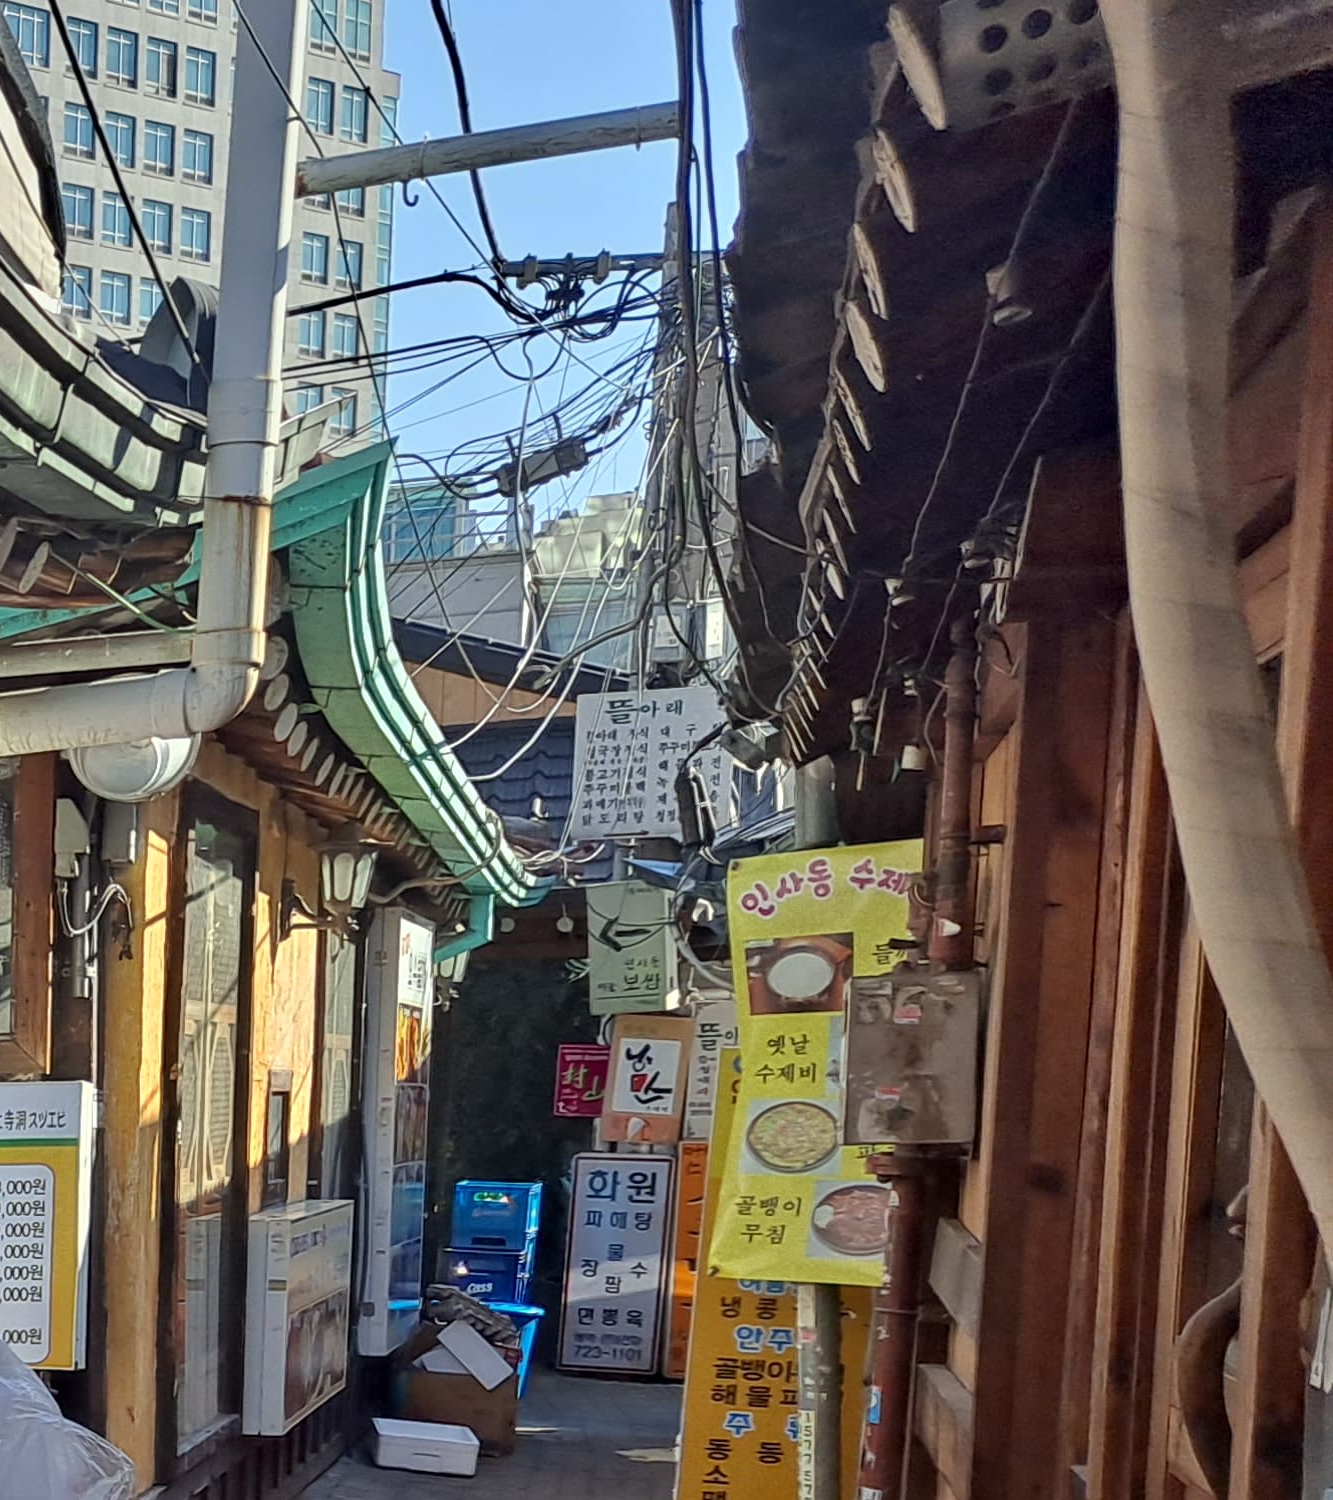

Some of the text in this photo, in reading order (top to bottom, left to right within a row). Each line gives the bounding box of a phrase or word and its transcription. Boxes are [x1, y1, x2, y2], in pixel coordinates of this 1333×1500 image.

[605, 697, 684, 725] 뜰아래
[740, 857, 911, 917] 인사동 수제
[767, 1034, 811, 1056] 옛날
[754, 1062, 817, 1084] 수제비
[586, 1169, 657, 1204] 화원
[735, 1195, 803, 1217] 골뱅이
[740, 1224, 786, 1245] 무침
[735, 1325, 794, 1353] 안주
[711, 1384, 798, 1409] 해물파
